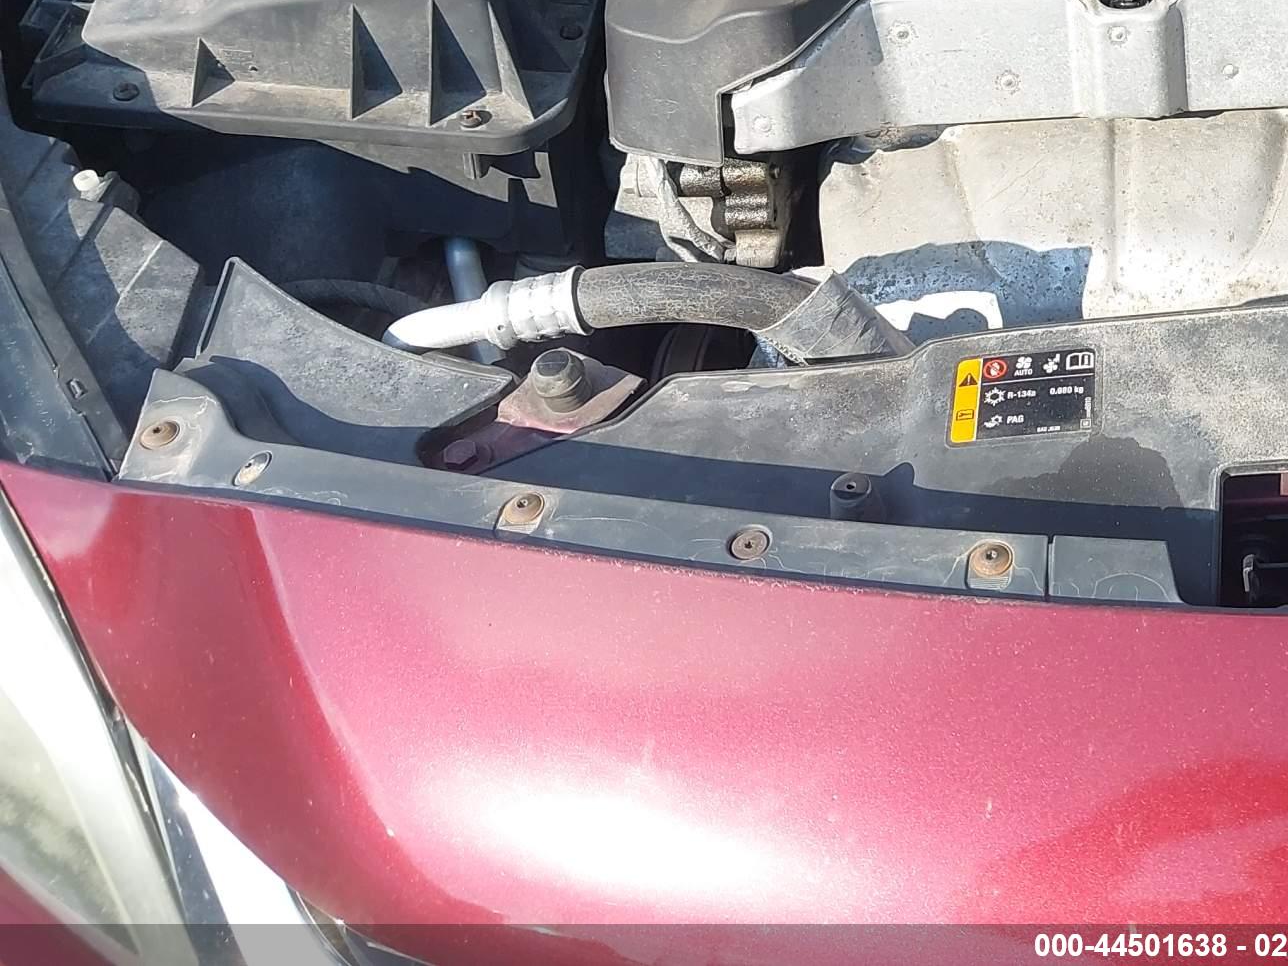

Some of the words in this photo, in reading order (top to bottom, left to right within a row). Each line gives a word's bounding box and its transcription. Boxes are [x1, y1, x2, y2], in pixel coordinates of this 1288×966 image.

[1014, 368, 1033, 377] AUTO
[1007, 389, 1037, 399] R-134a
[1074, 385, 1084, 394] kg
[1006, 414, 1024, 424] PAG
